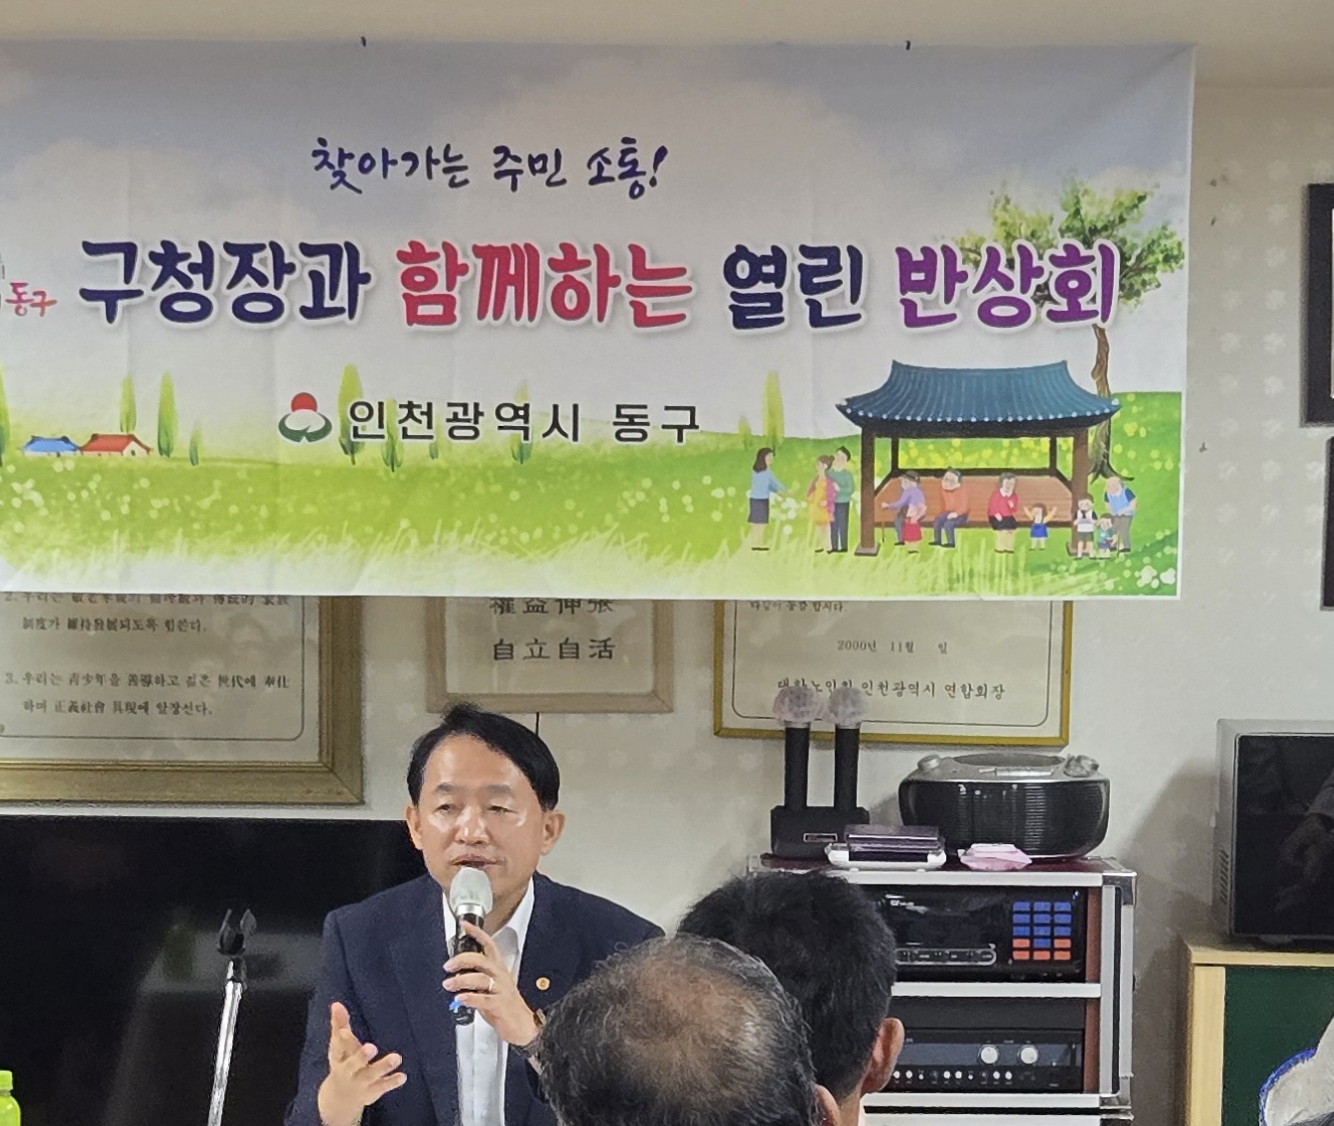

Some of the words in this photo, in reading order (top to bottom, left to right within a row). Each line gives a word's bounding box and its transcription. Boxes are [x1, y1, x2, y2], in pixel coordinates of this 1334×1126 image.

[312, 137, 469, 194] 찾아가는
[493, 145, 567, 192] 주민
[588, 136, 668, 199] 소통!
[5, 282, 57, 317] 동구
[79, 240, 371, 325] 구청장과
[396, 240, 693, 328] 함께하는
[723, 243, 864, 329] 열린
[895, 242, 1119, 328] 반상회
[348, 400, 581, 442] 인천광역시
[612, 403, 701, 444] 동구
[493, 637, 616, 661] 自立自活
[837, 640, 877, 653] 2000년
[861, 681, 935, 697] 인천광역시
